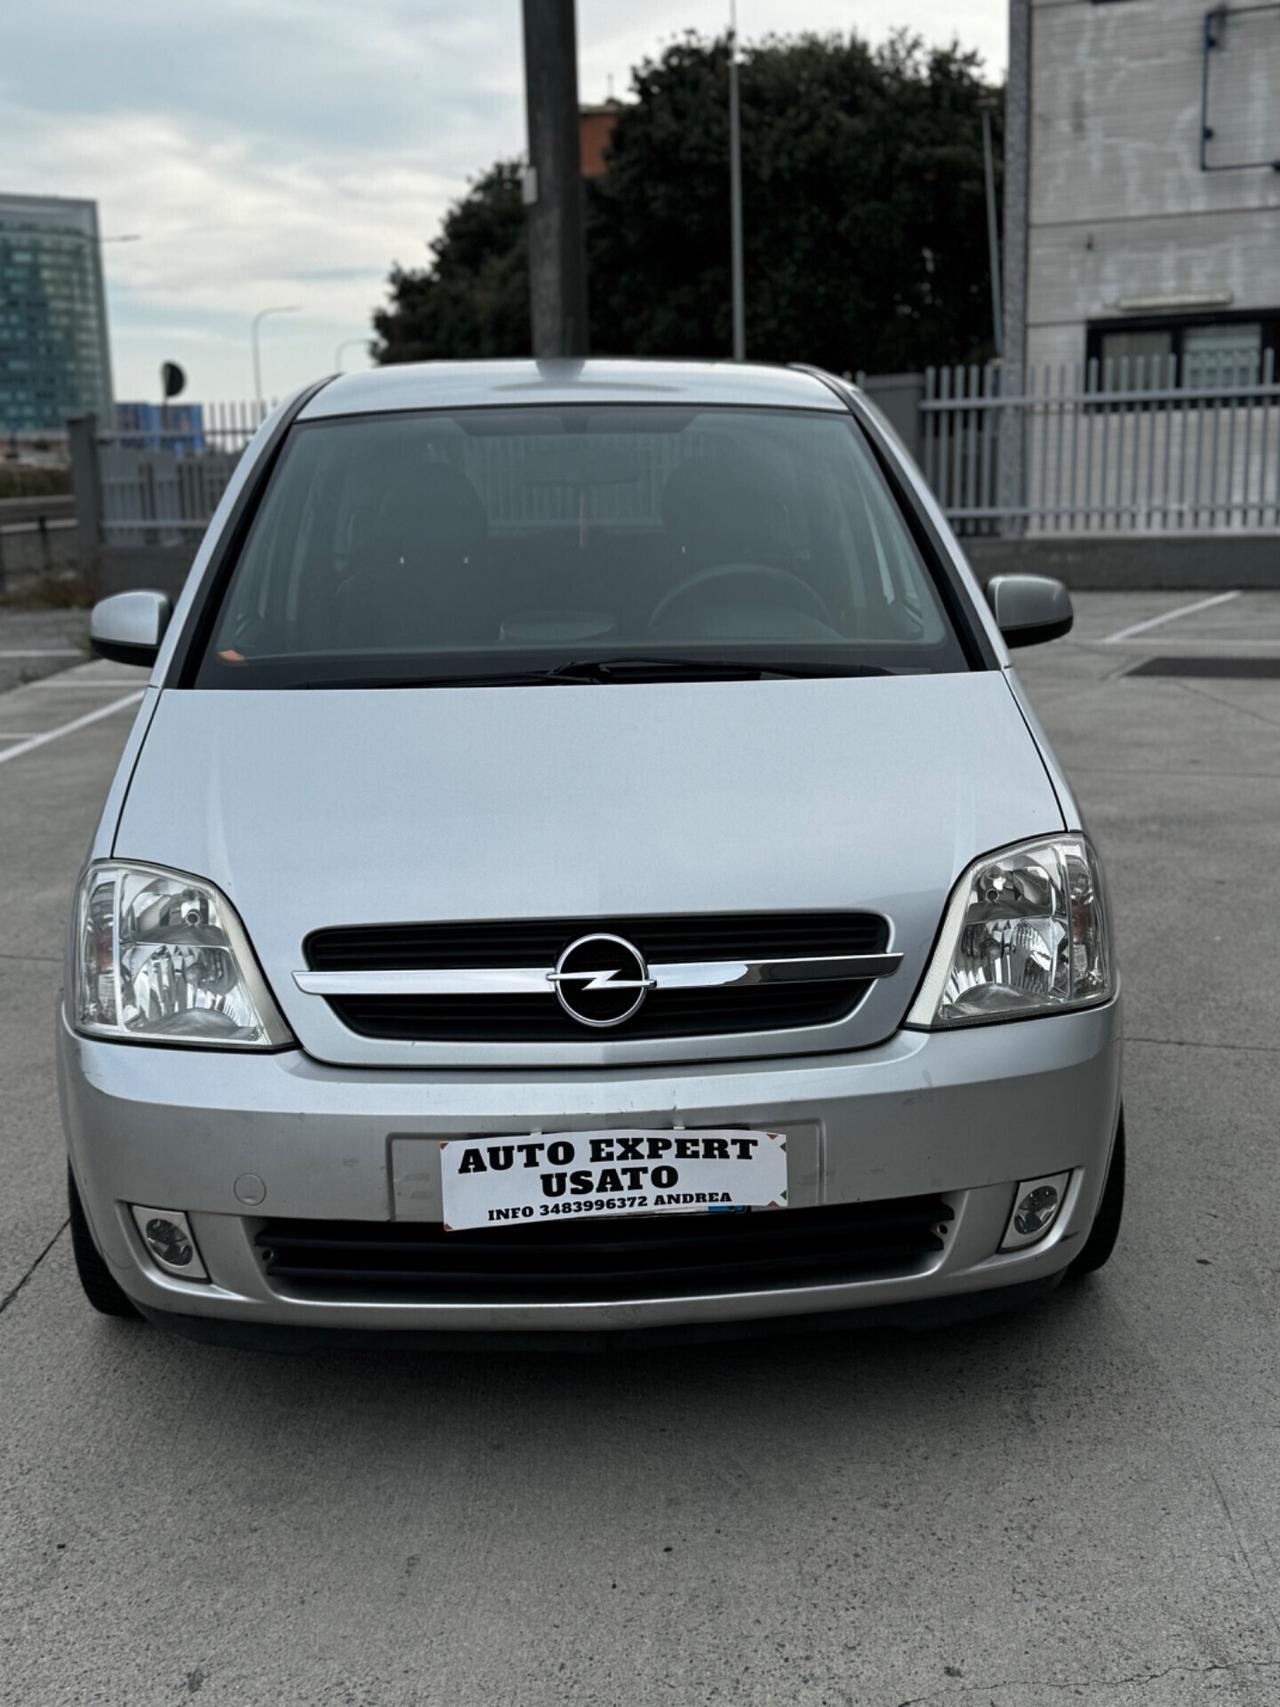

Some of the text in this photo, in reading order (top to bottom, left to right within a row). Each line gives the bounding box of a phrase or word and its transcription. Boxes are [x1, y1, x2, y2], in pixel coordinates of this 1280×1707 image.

[458, 1137, 759, 1174] AUTO EXPERT
[540, 1165, 679, 1198] USATO
[488, 1192, 733, 1221] INFO 3483996372 ANDREA
